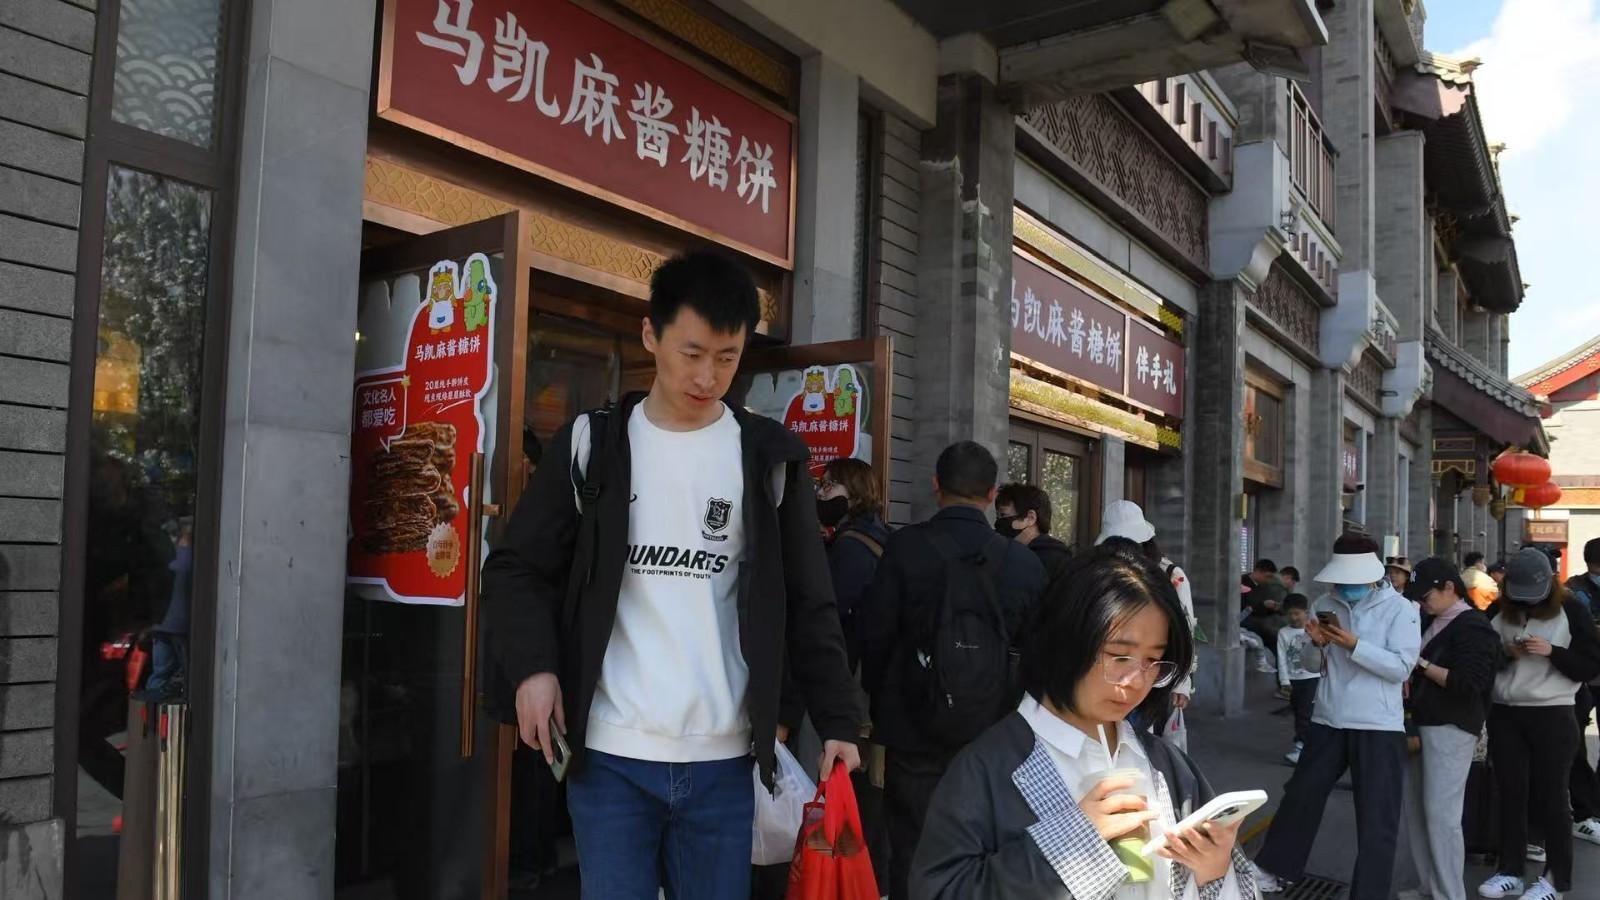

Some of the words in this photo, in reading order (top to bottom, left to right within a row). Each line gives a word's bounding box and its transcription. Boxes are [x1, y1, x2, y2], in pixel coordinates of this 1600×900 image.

[416, 0, 777, 213] 马凯麻酱糖饼
[415, 335, 481, 362] 马凯麻酱糖饼
[1136, 346, 1177, 395] 伴手礼
[363, 387, 397, 406] 文化名人
[361, 406, 397, 428] 都爱吃
[790, 420, 849, 433] 马凯麻酱糖饼
[642, 568, 682, 577] FOOTPRINTS
